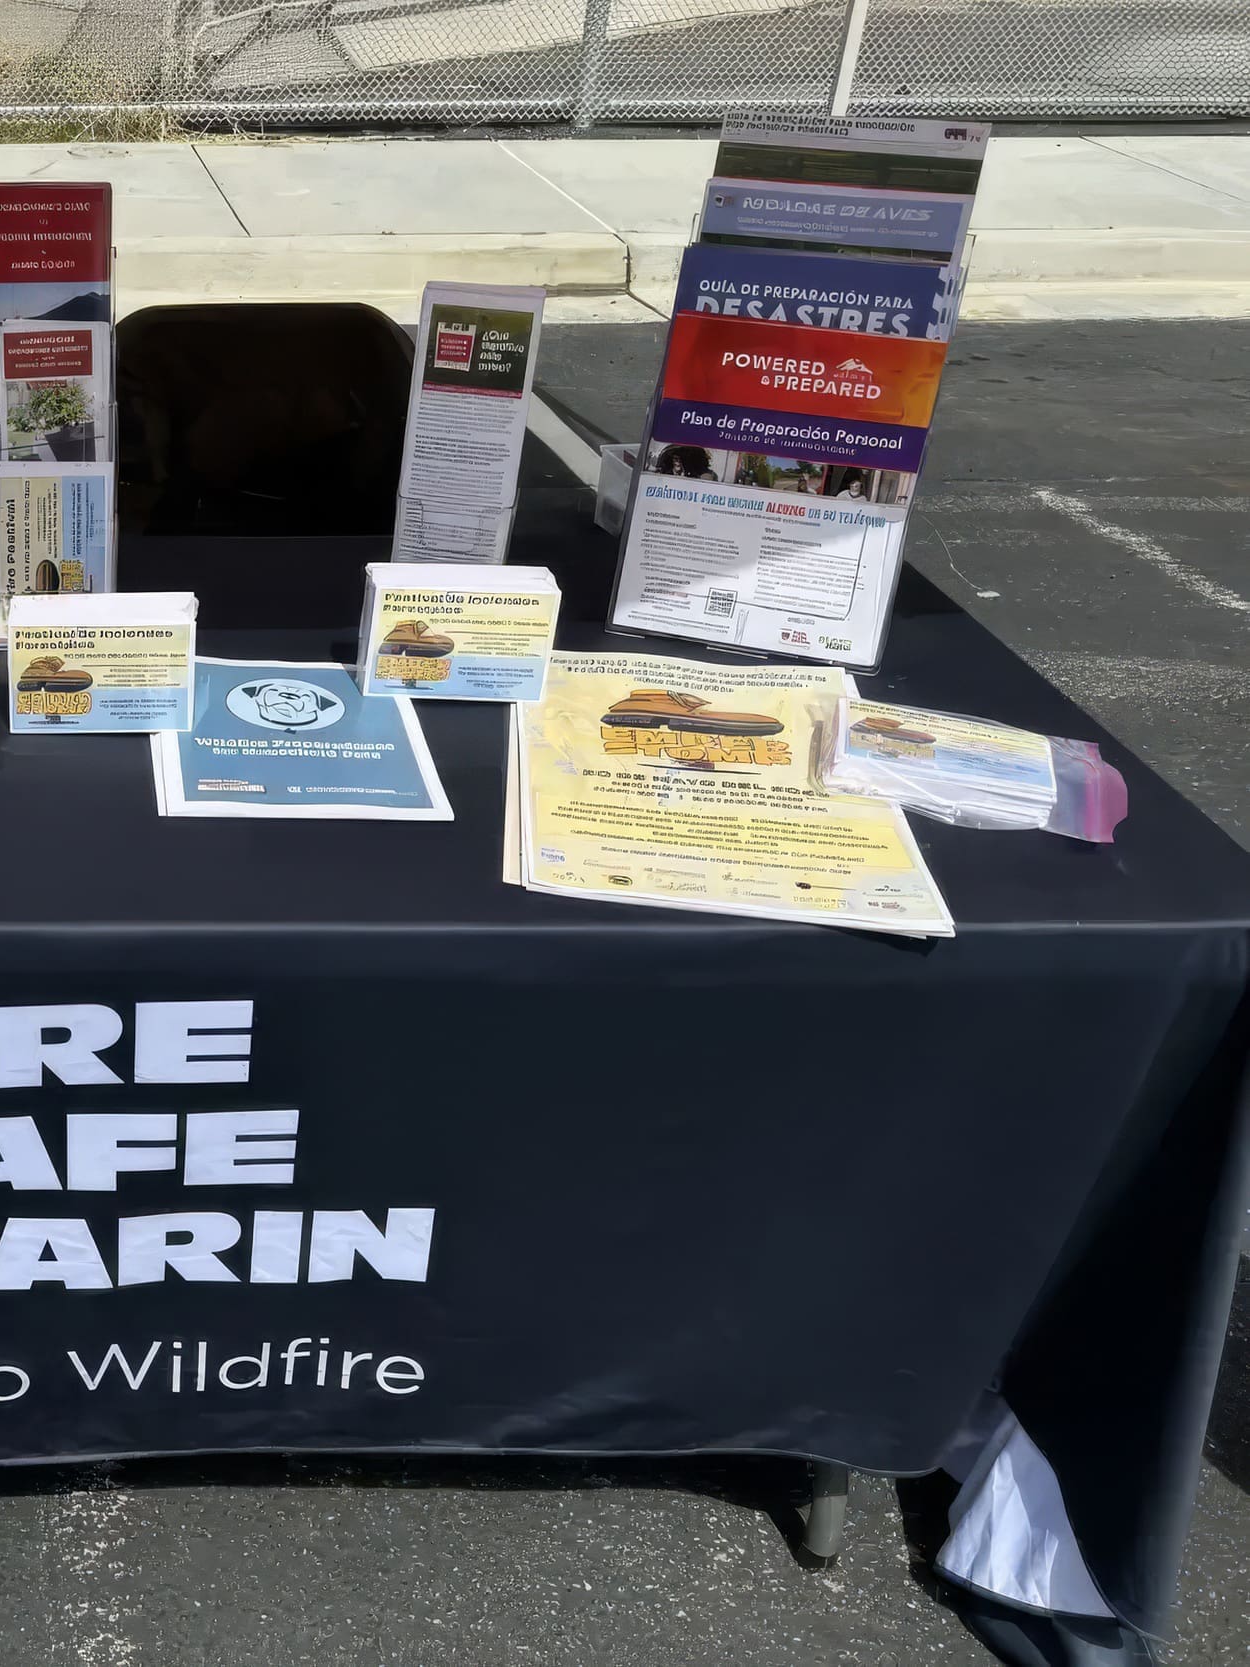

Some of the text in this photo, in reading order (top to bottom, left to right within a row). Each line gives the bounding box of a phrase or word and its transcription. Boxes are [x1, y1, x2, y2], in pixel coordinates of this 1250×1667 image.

[874, 295, 914, 310] PARA
[721, 351, 825, 376] POWERED
[773, 375, 882, 400] PREPARED
[66, 1337, 426, 1396] Wildfire
